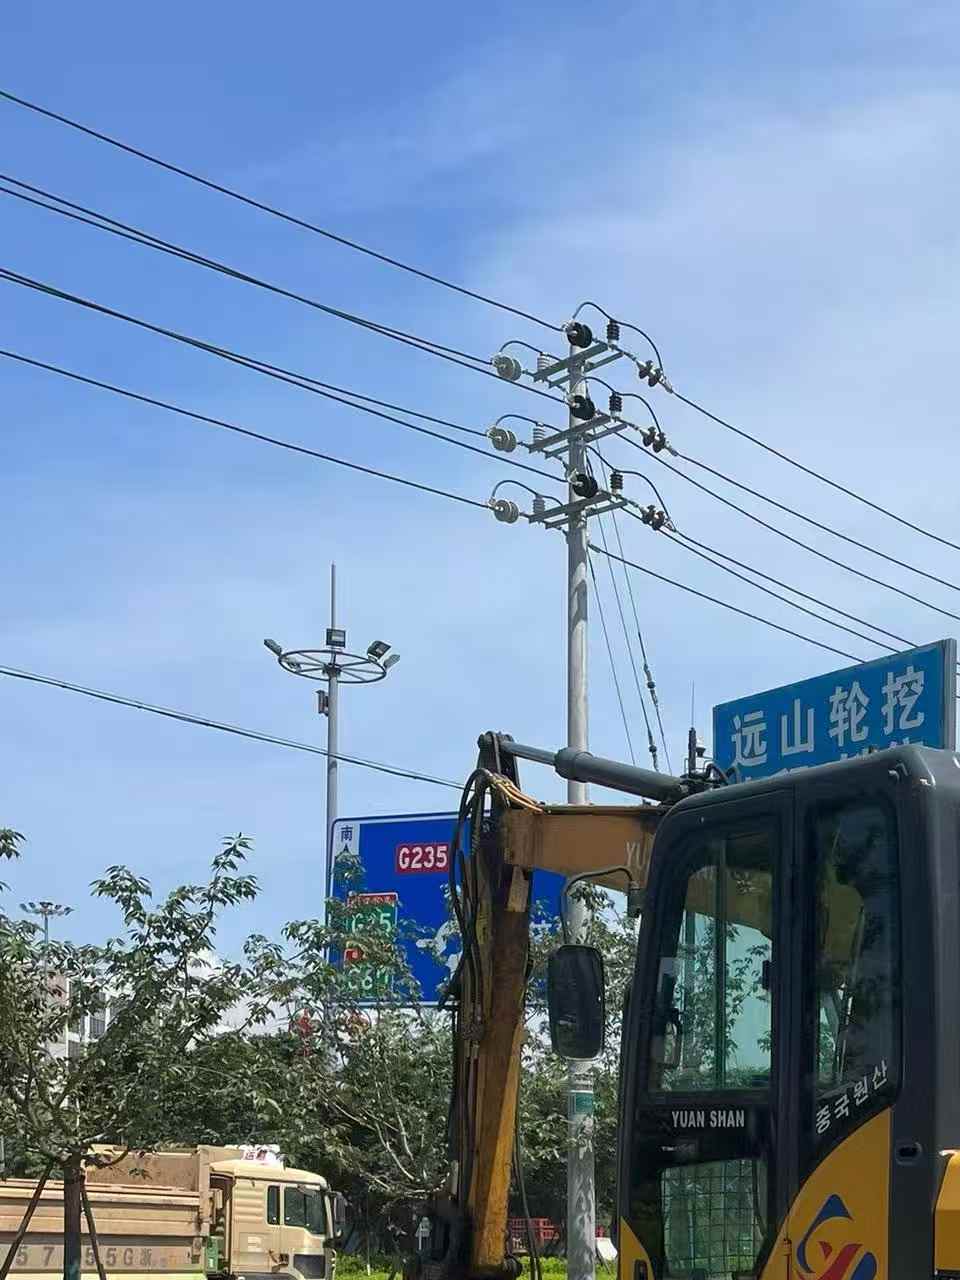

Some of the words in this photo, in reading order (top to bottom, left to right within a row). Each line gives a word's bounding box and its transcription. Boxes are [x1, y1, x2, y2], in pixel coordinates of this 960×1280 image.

[731, 666, 924, 766] 远山轮挖
[341, 825, 353, 842] 南
[398, 846, 448, 869] G235
[672, 1110, 705, 1128] YUAN
[710, 1110, 745, 1128] SHAN
